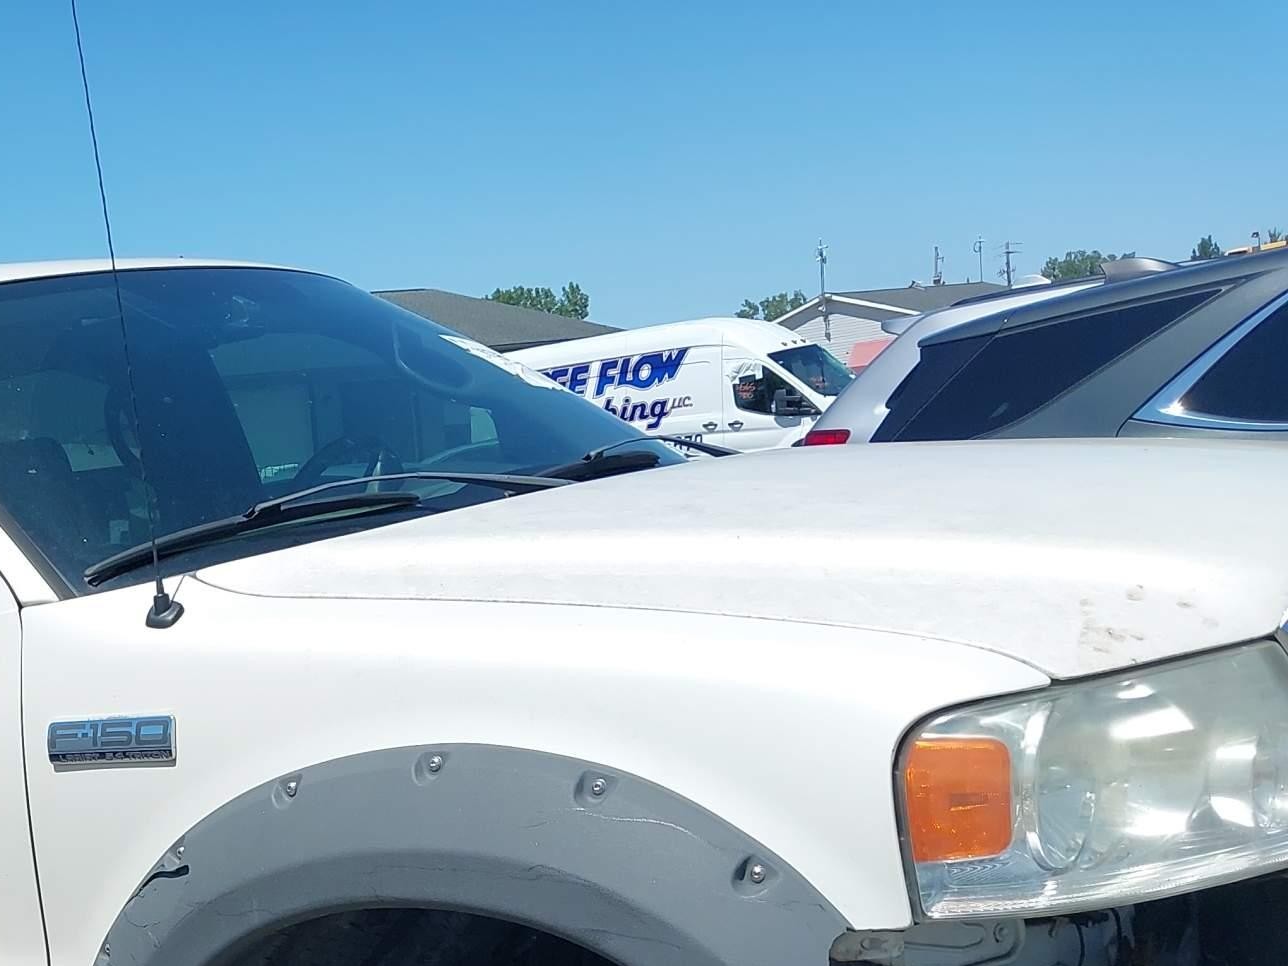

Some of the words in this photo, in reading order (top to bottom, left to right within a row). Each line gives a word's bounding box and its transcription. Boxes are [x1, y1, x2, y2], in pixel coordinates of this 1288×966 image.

[542, 365, 590, 395] EE
[594, 348, 689, 397] FLOW
[50, 719, 171, 749] F-150
